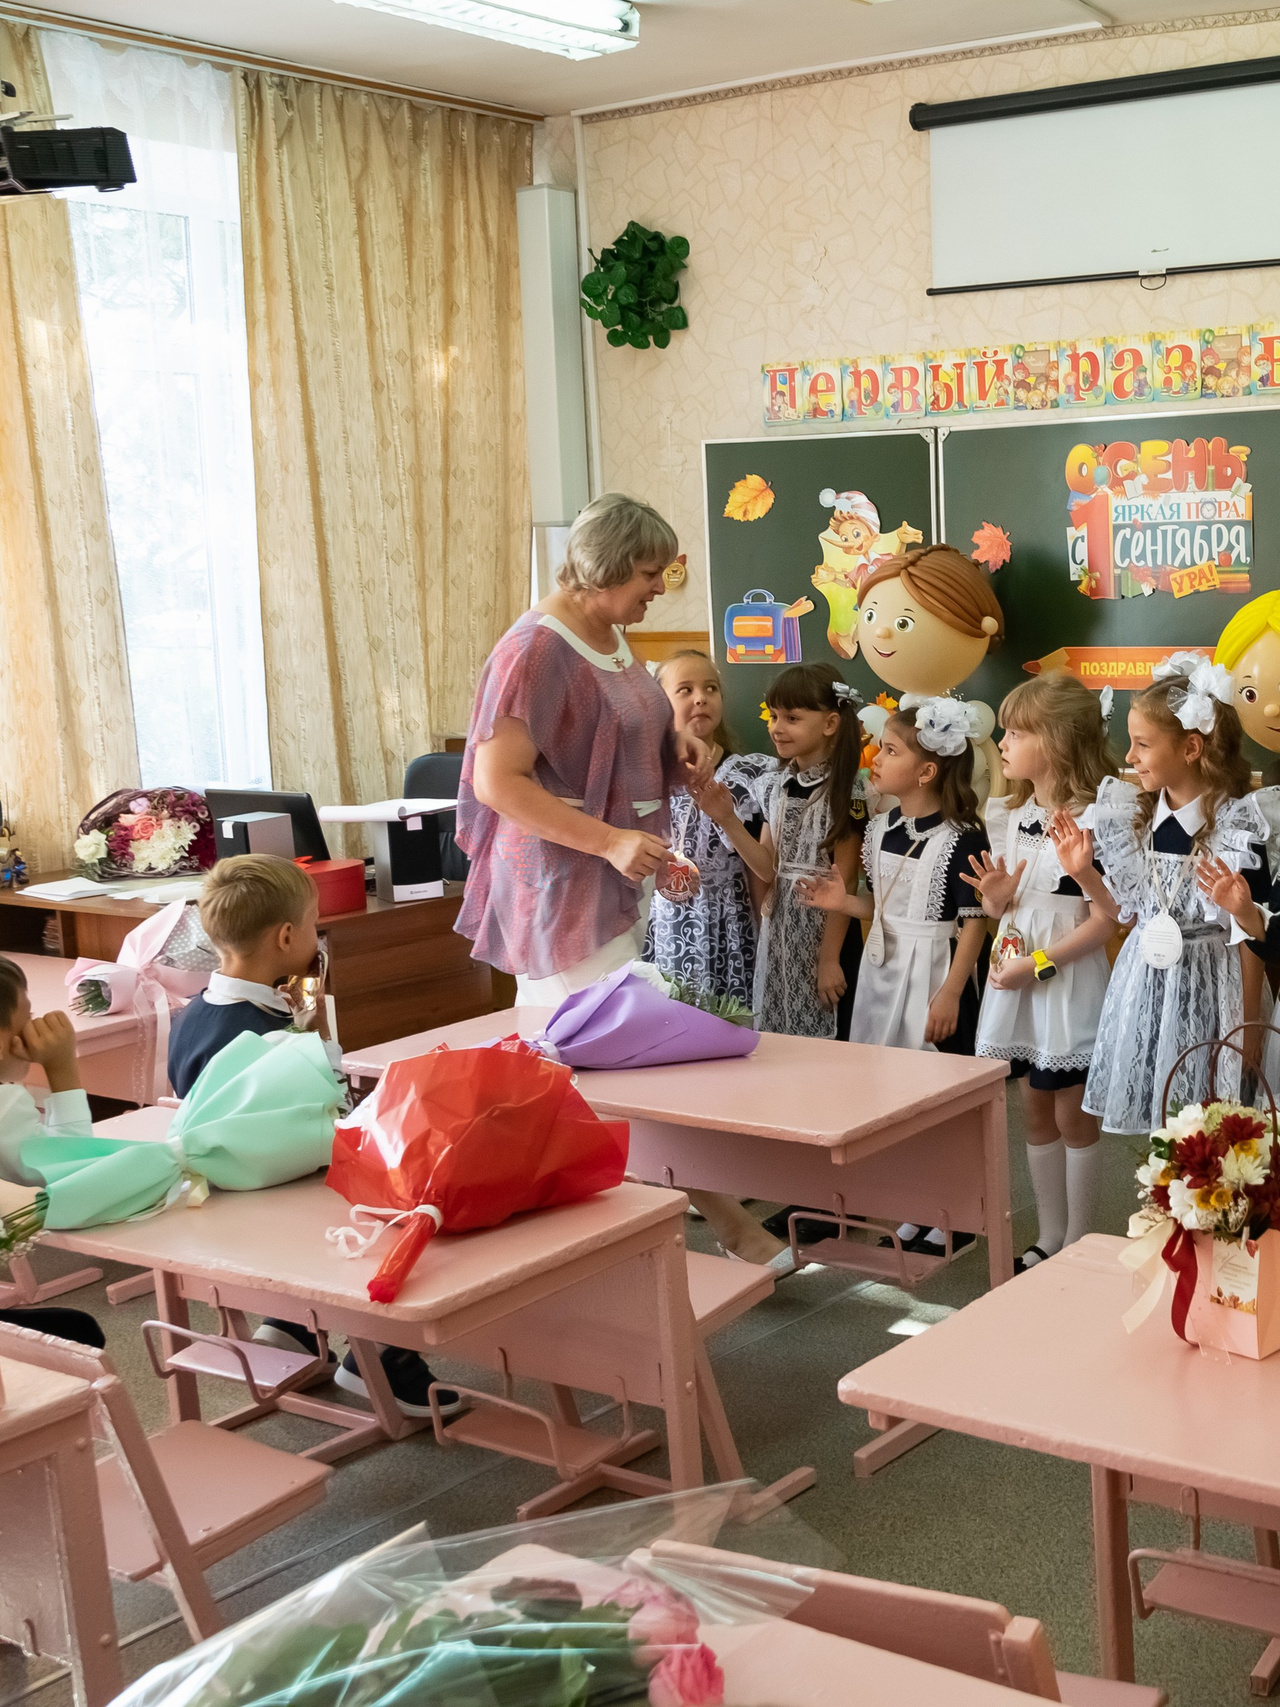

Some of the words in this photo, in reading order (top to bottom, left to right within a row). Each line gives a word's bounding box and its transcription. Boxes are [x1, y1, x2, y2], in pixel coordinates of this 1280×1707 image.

[764, 350, 1011, 421] Первый
[1064, 343, 1195, 401] раз
[1065, 437, 1248, 494] ОСЕНЬ
[1113, 503, 1181, 522] ЯРКАЯ
[1070, 492, 1114, 600] 1
[1172, 565, 1214, 592] УРА!
[1081, 661, 1163, 678] ПОЗДРАВЛ
